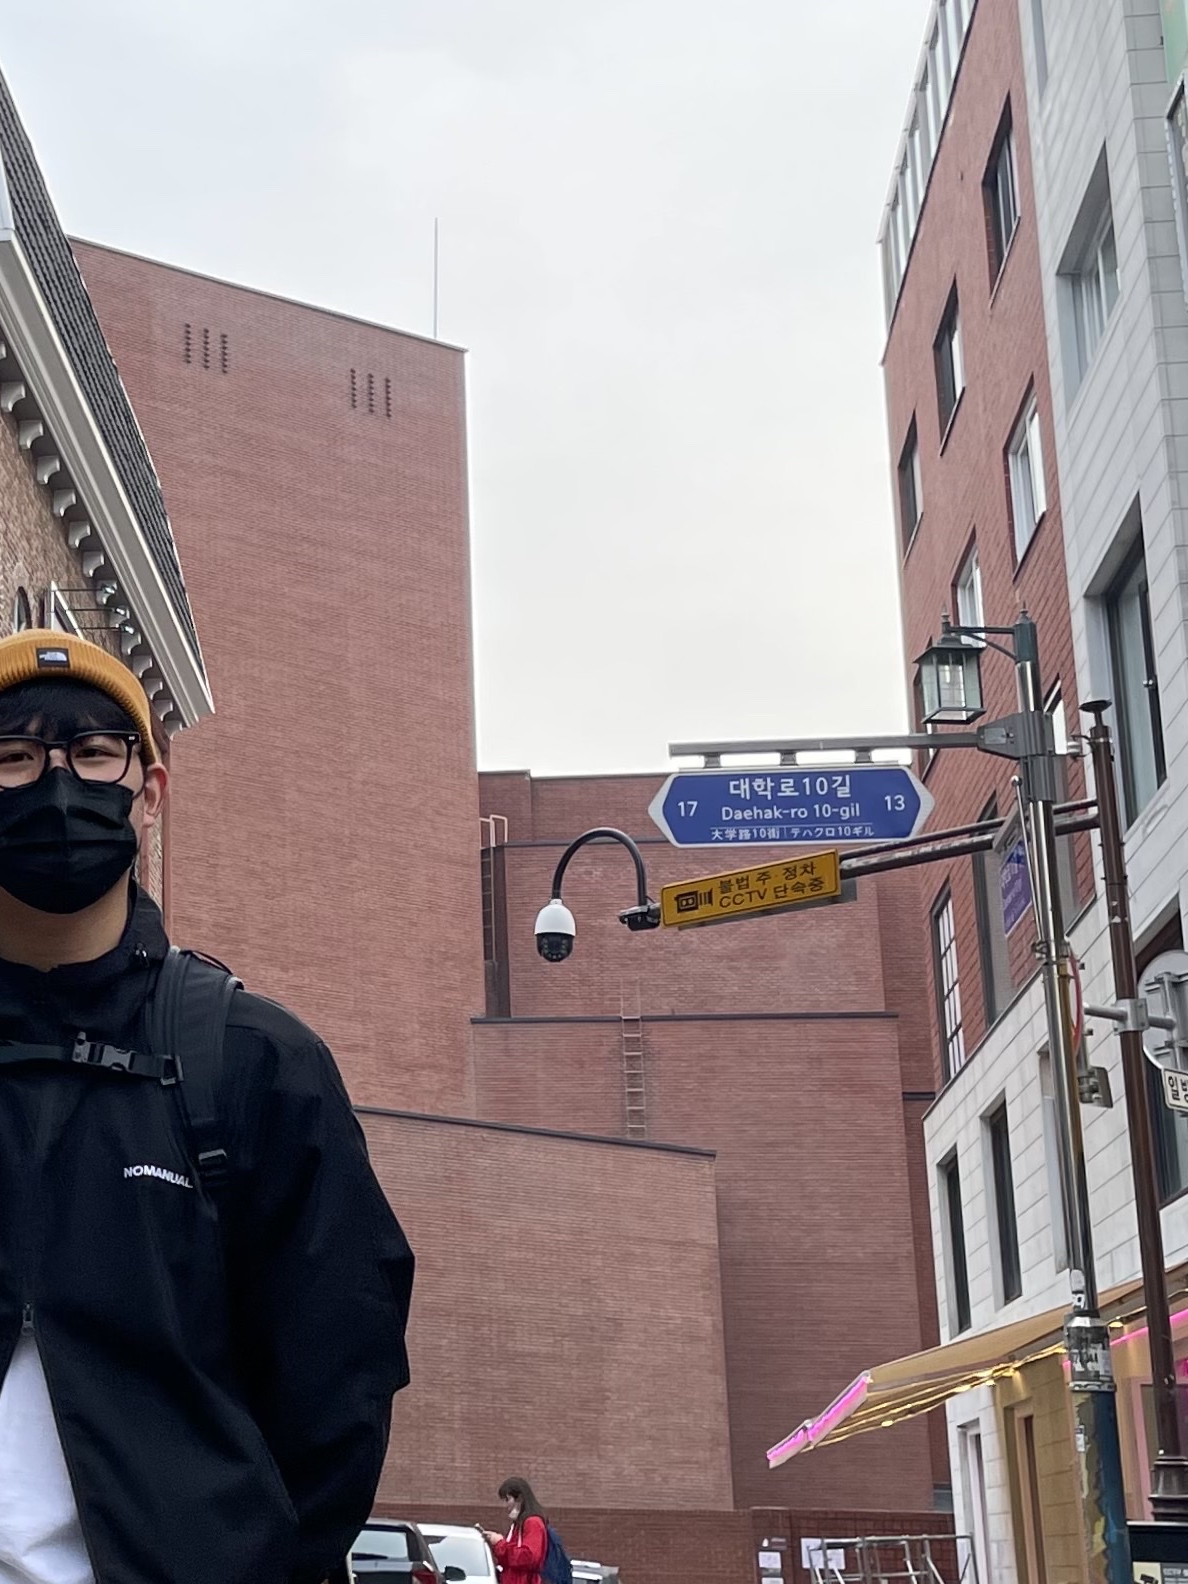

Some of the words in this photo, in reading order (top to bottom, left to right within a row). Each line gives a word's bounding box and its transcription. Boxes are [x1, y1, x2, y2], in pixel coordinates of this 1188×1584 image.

[729, 774, 852, 800] 대학로10길
[677, 801, 698, 818] 17
[721, 804, 809, 822] Daehak-ro
[813, 802, 861, 822] 10-gil
[884, 795, 906, 812] 13
[718, 875, 750, 895] 불법
[719, 888, 768, 909] CCTV
[773, 877, 825, 900] 단속중
[123, 1165, 193, 1189] NOMANUAL
